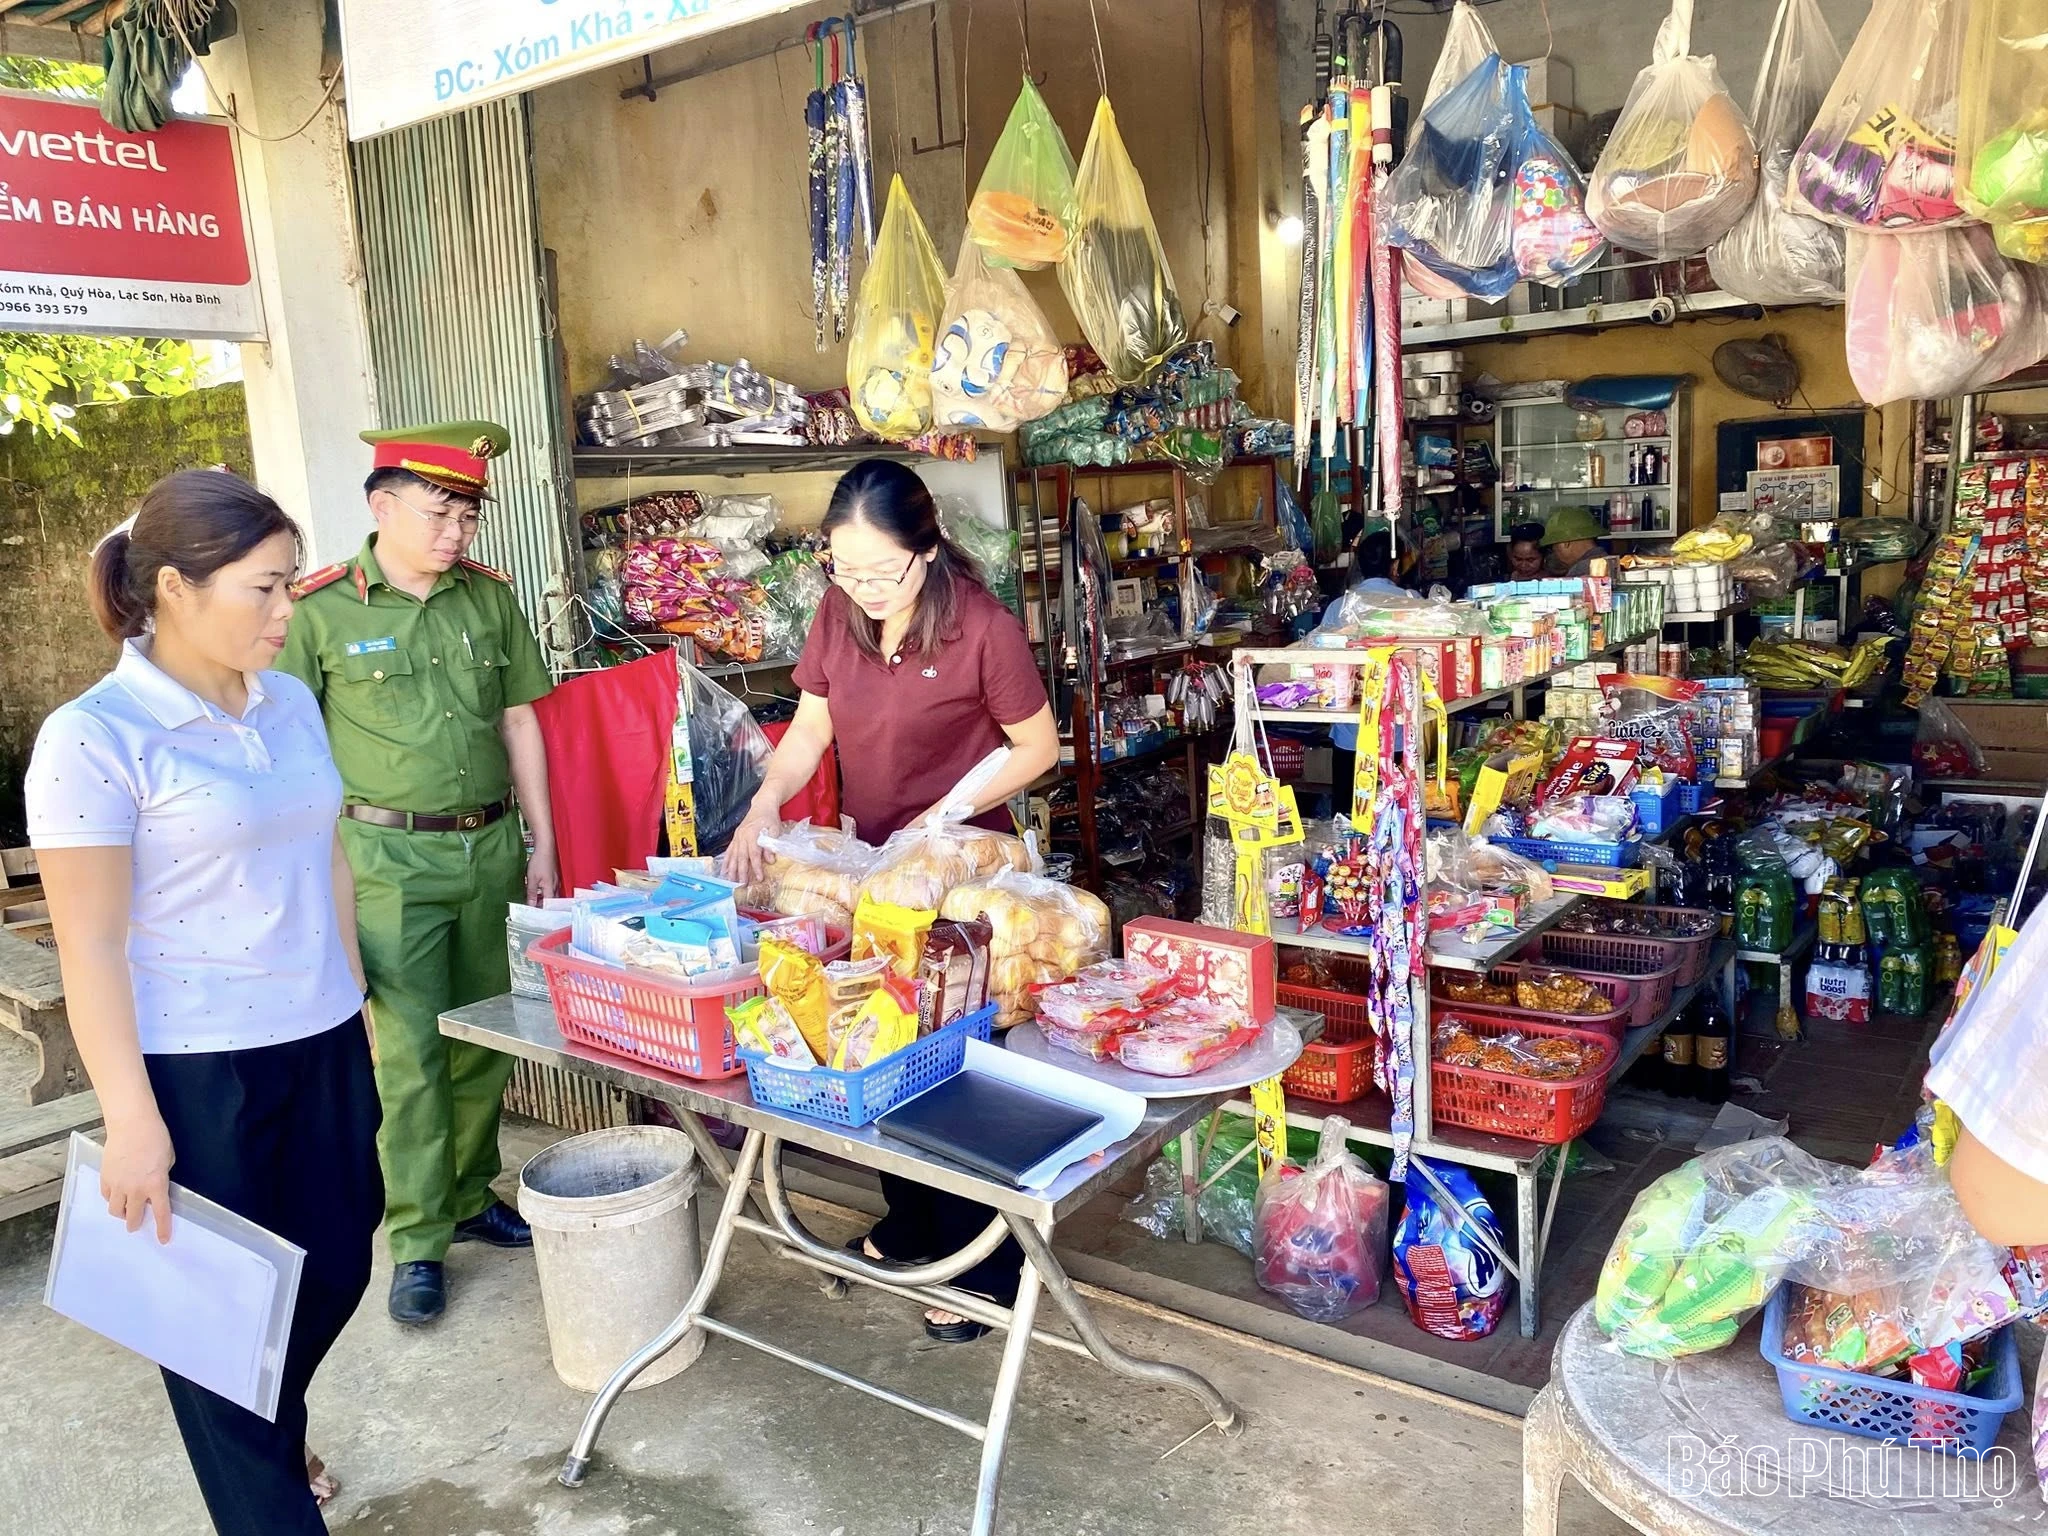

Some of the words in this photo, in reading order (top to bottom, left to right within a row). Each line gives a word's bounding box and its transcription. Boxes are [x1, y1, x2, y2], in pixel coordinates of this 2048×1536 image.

[434, 60, 484, 101] ĐC:
[493, 36, 560, 80] Xóm
[52, 195, 122, 230] BÁN
[132, 202, 220, 238] HÀNG
[28, 284, 57, 298] Khả,
[60, 286, 84, 300] Quý
[88, 288, 116, 300] Hòa,
[118, 289, 139, 302] Lạc
[142, 291, 167, 303] Sơn,
[170, 292, 192, 303] Hòa
[195, 293, 221, 304] Bình
[35, 303, 60, 315] 393
[63, 304, 88, 315] 579
